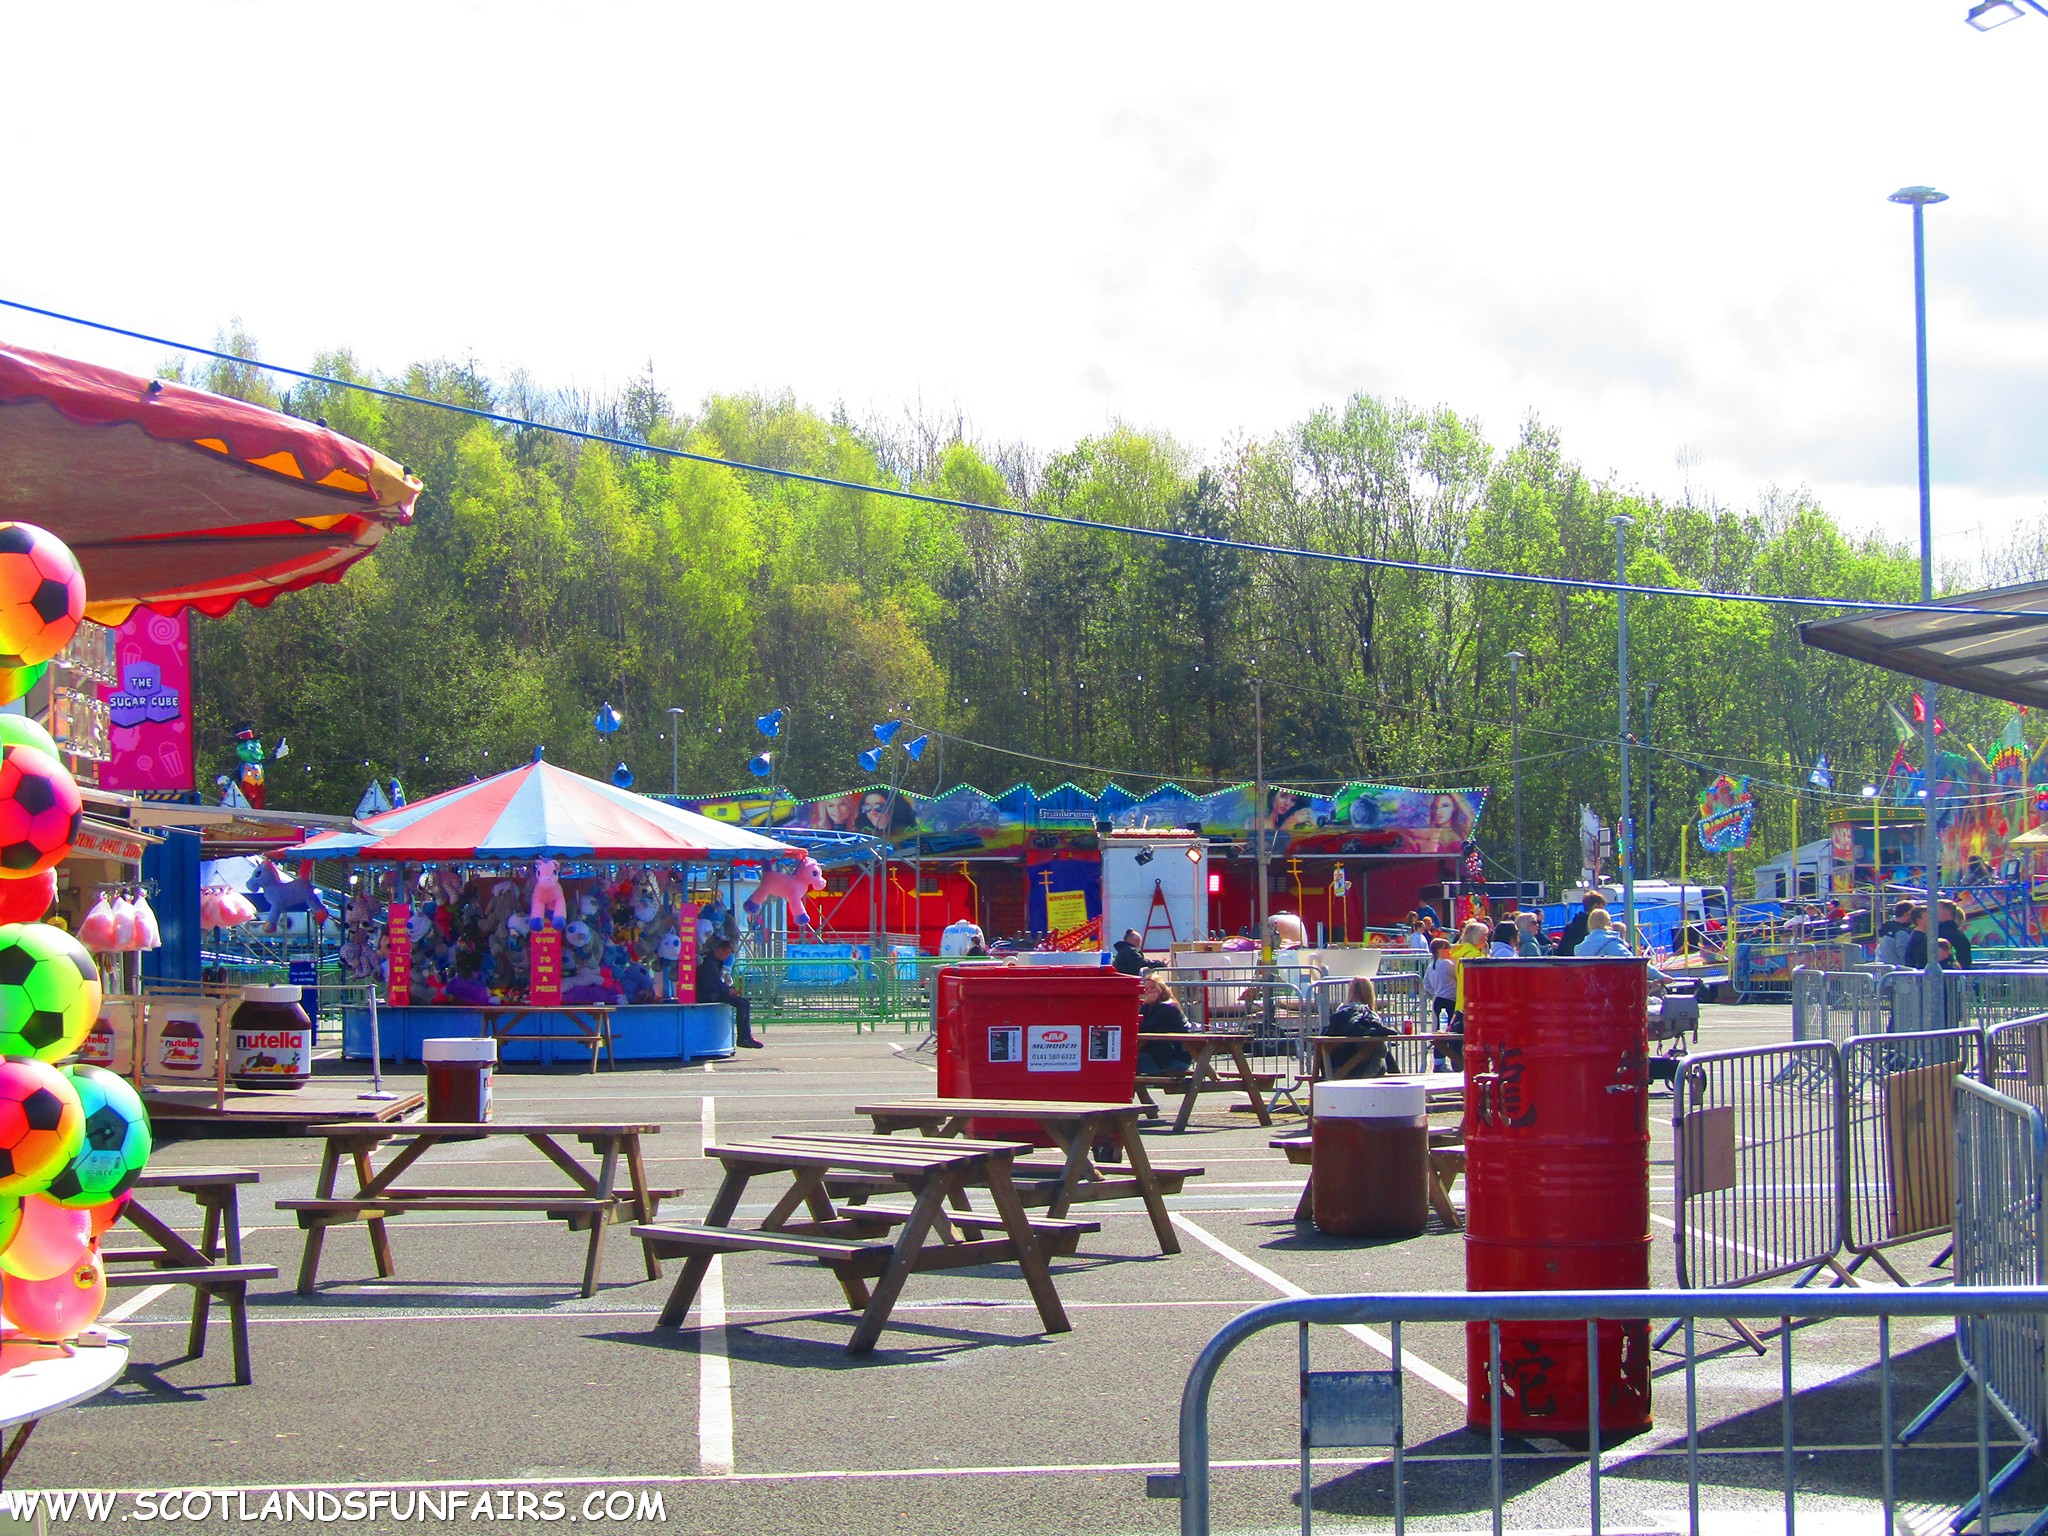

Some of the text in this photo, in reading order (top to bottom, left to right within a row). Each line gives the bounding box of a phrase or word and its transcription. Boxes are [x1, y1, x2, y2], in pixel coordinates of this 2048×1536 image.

[131, 677, 152, 688] THE
[109, 696, 179, 708] SUGAR CUBE
[164, 1037, 199, 1048] nutella
[236, 1031, 303, 1050] nutella
[1031, 1053, 1047, 1061] 0141
